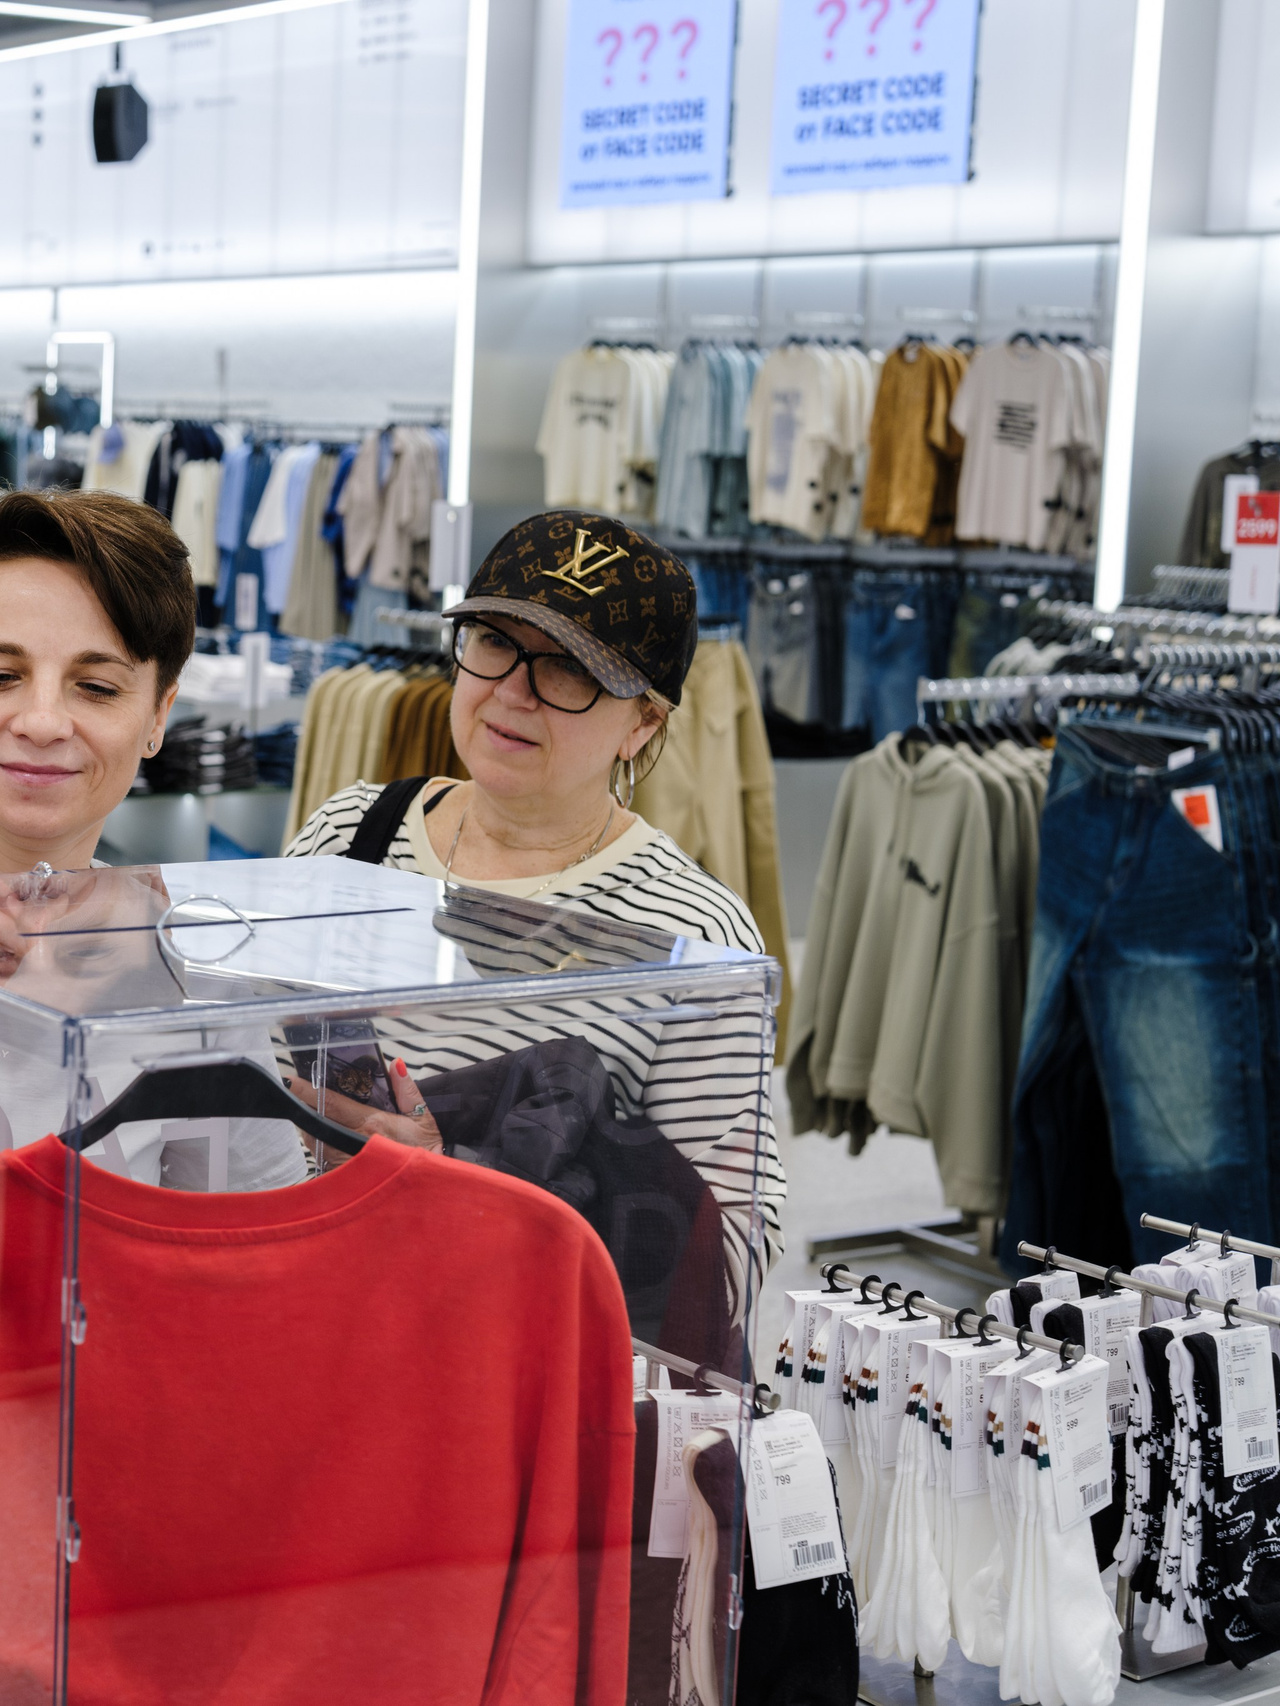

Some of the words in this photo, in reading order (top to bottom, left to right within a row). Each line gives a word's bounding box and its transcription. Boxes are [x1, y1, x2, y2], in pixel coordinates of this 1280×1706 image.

[797, 79, 878, 110] SECRET
[883, 72, 946, 100] CODE
[582, 103, 650, 132] SECRET
[654, 98, 706, 126] CODE
[822, 113, 875, 138] FACE
[881, 106, 943, 134] CODE
[603, 134, 648, 159] FACE
[653, 129, 704, 155] CODE
[1106, 1347, 1118, 1357] 799
[1234, 1376, 1245, 1386] 799
[1066, 1418, 1079, 1431] 599
[774, 1474, 791, 1486] 799
